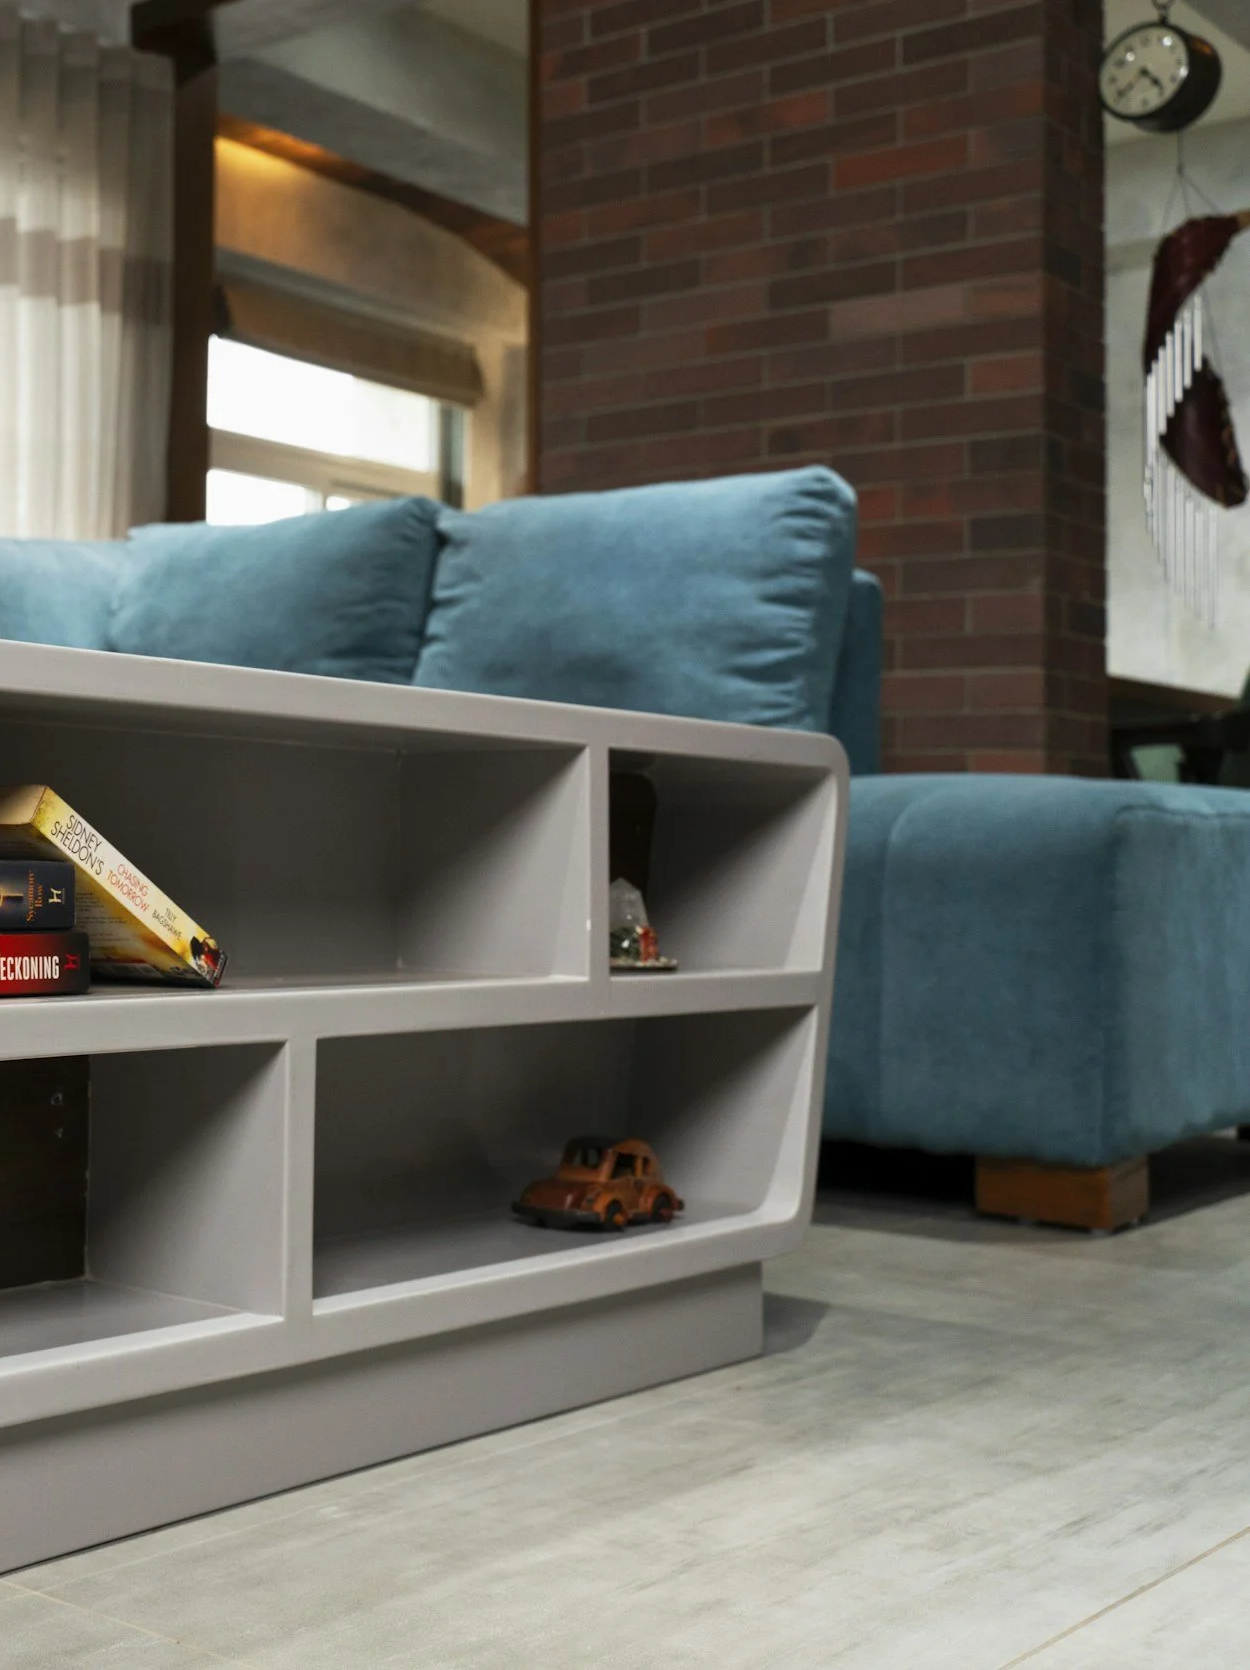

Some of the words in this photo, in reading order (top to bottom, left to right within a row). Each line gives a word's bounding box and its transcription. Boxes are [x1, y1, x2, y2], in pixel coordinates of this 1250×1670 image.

[50, 821, 104, 875] SHELDON'S
[66, 814, 102, 852] SIDNEY
[107, 869, 149, 912] TOMORROW
[117, 863, 149, 896] CHASING
